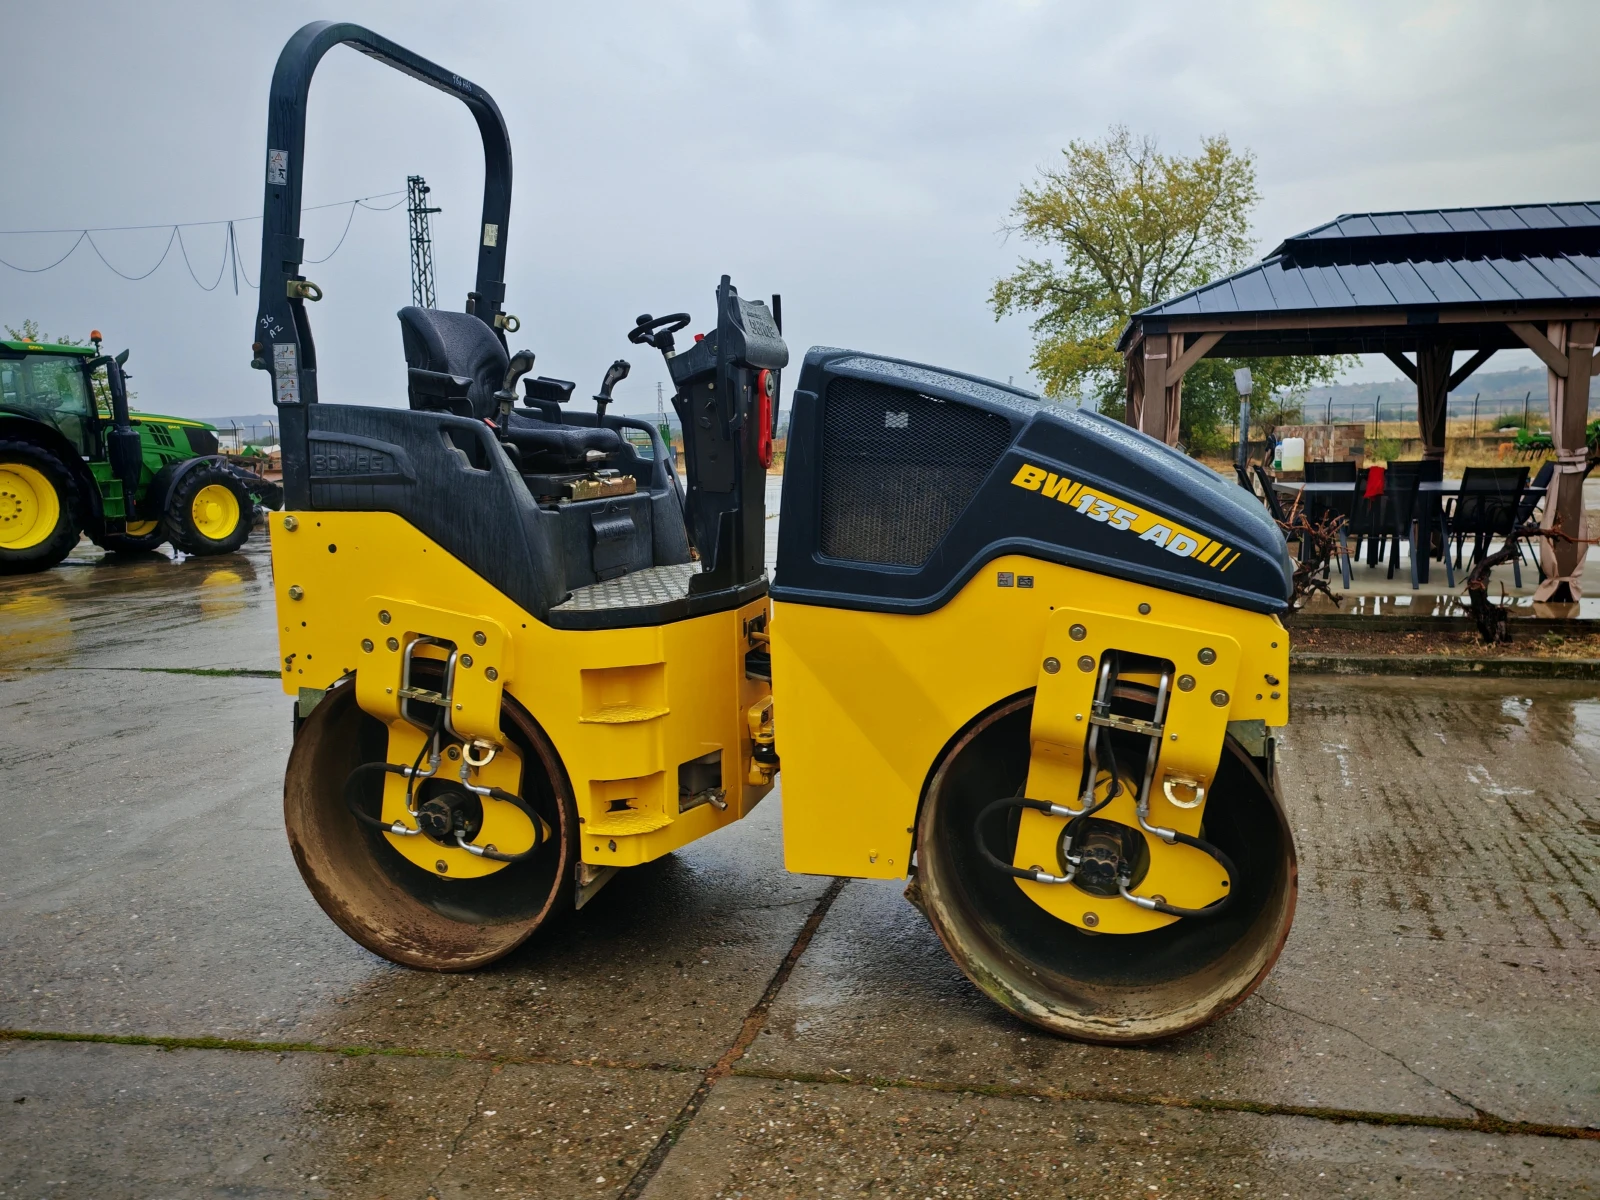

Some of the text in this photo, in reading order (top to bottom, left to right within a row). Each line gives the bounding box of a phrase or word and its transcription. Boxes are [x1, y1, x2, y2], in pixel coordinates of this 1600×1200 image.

[261, 314, 274, 328] 36
[1011, 463, 1199, 557] BW 135 AD
